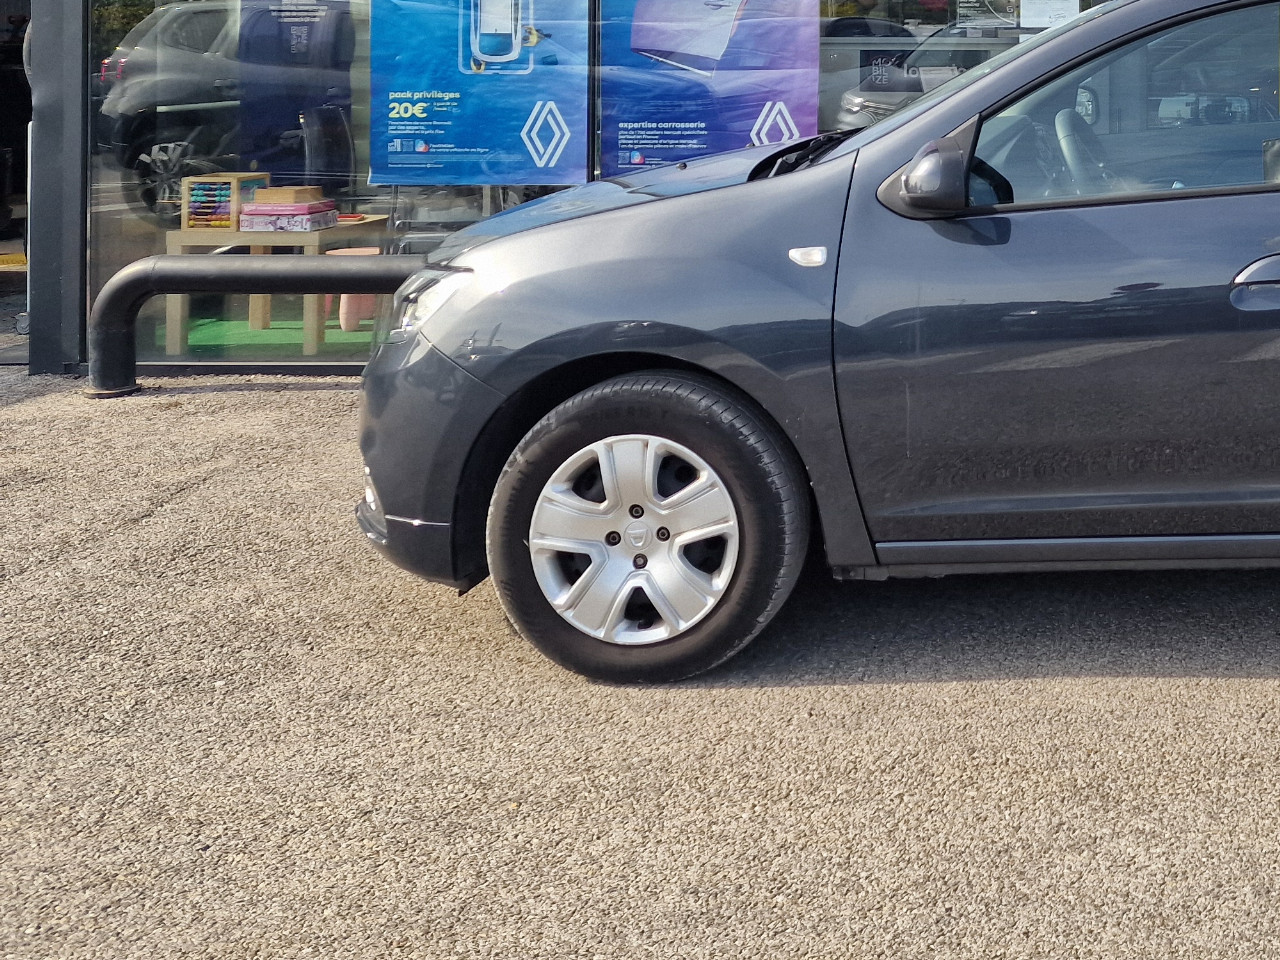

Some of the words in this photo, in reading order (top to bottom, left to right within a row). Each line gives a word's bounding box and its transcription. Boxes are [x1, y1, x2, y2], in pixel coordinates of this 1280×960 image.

[389, 90, 412, 100] pack
[413, 90, 460, 101] privilèges
[618, 121, 657, 130] expertise
[658, 121, 706, 129] carrosserie
